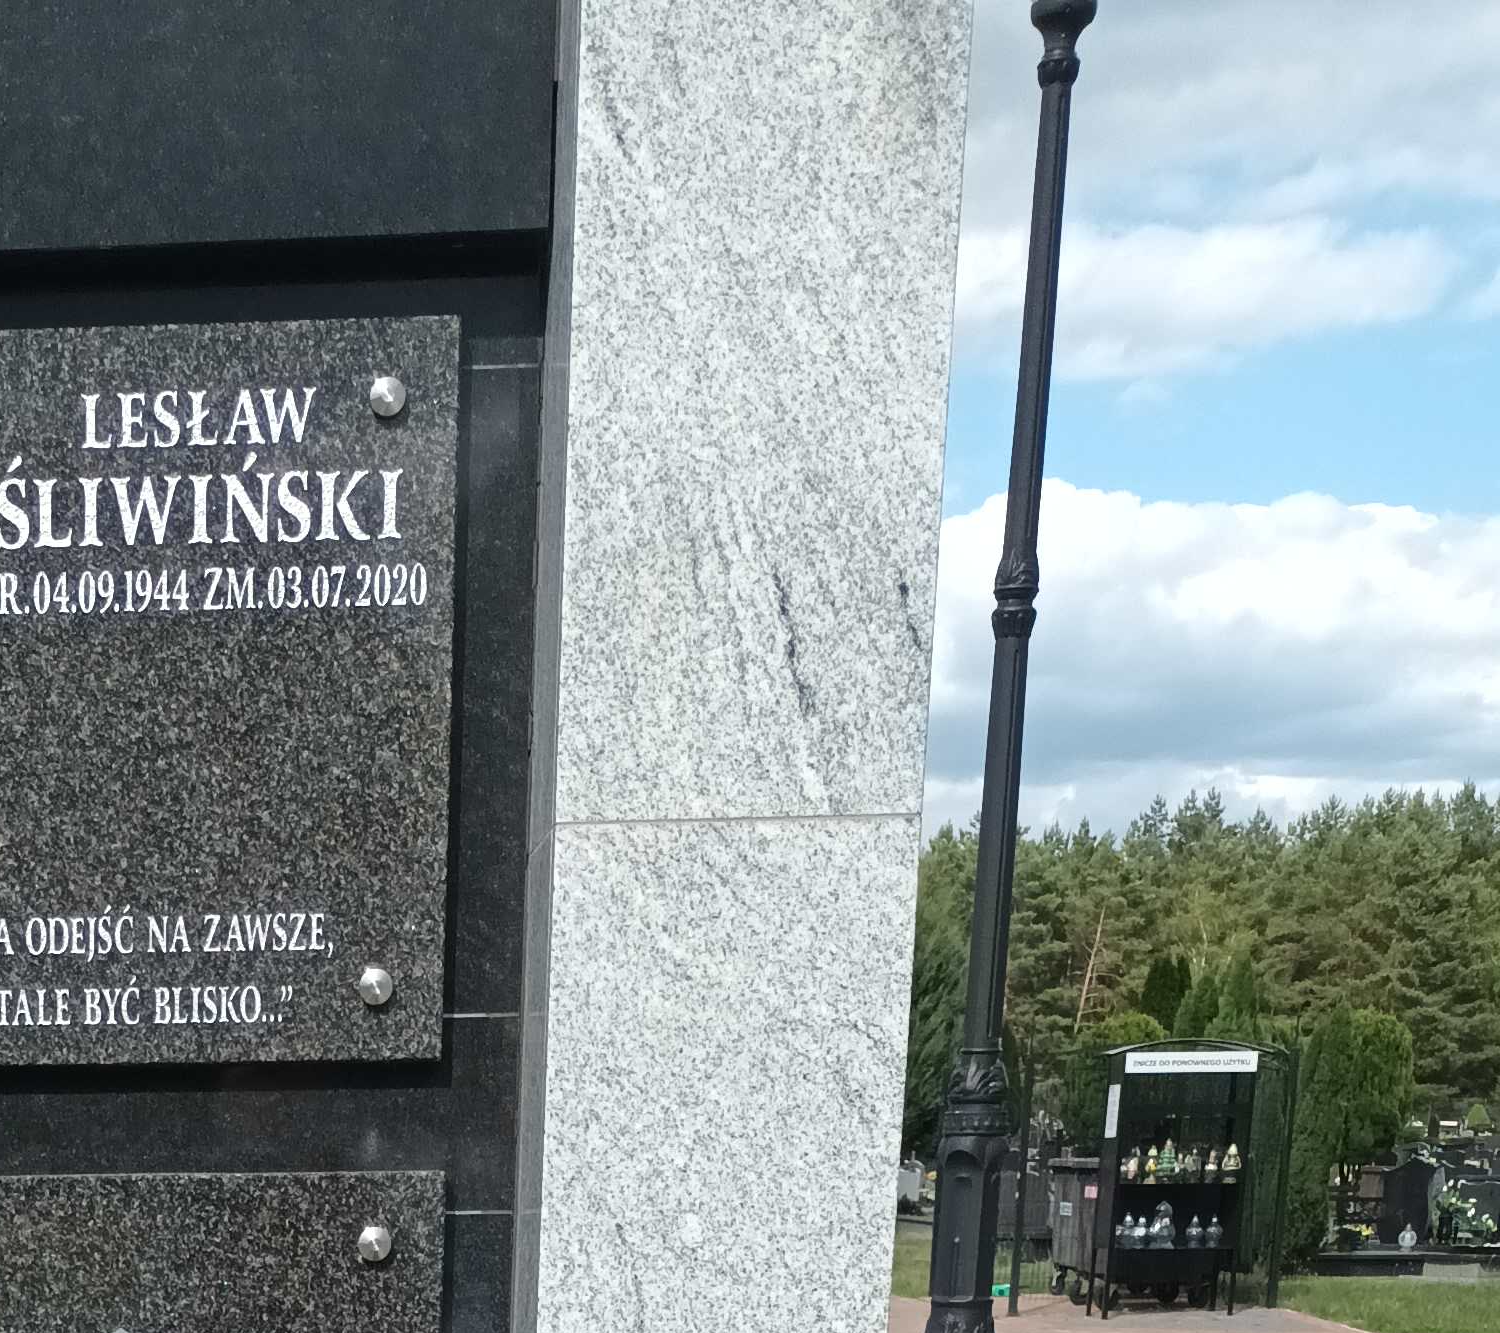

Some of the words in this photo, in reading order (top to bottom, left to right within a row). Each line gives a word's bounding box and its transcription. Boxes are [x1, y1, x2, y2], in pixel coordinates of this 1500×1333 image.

[80, 386, 317, 449] LESŁAW
[24, 903, 134, 963] ODEJŚĆ
[146, 914, 192, 954] NA
[202, 911, 334, 958] ZAWSZE,
[83, 976, 140, 1026] BYĆ
